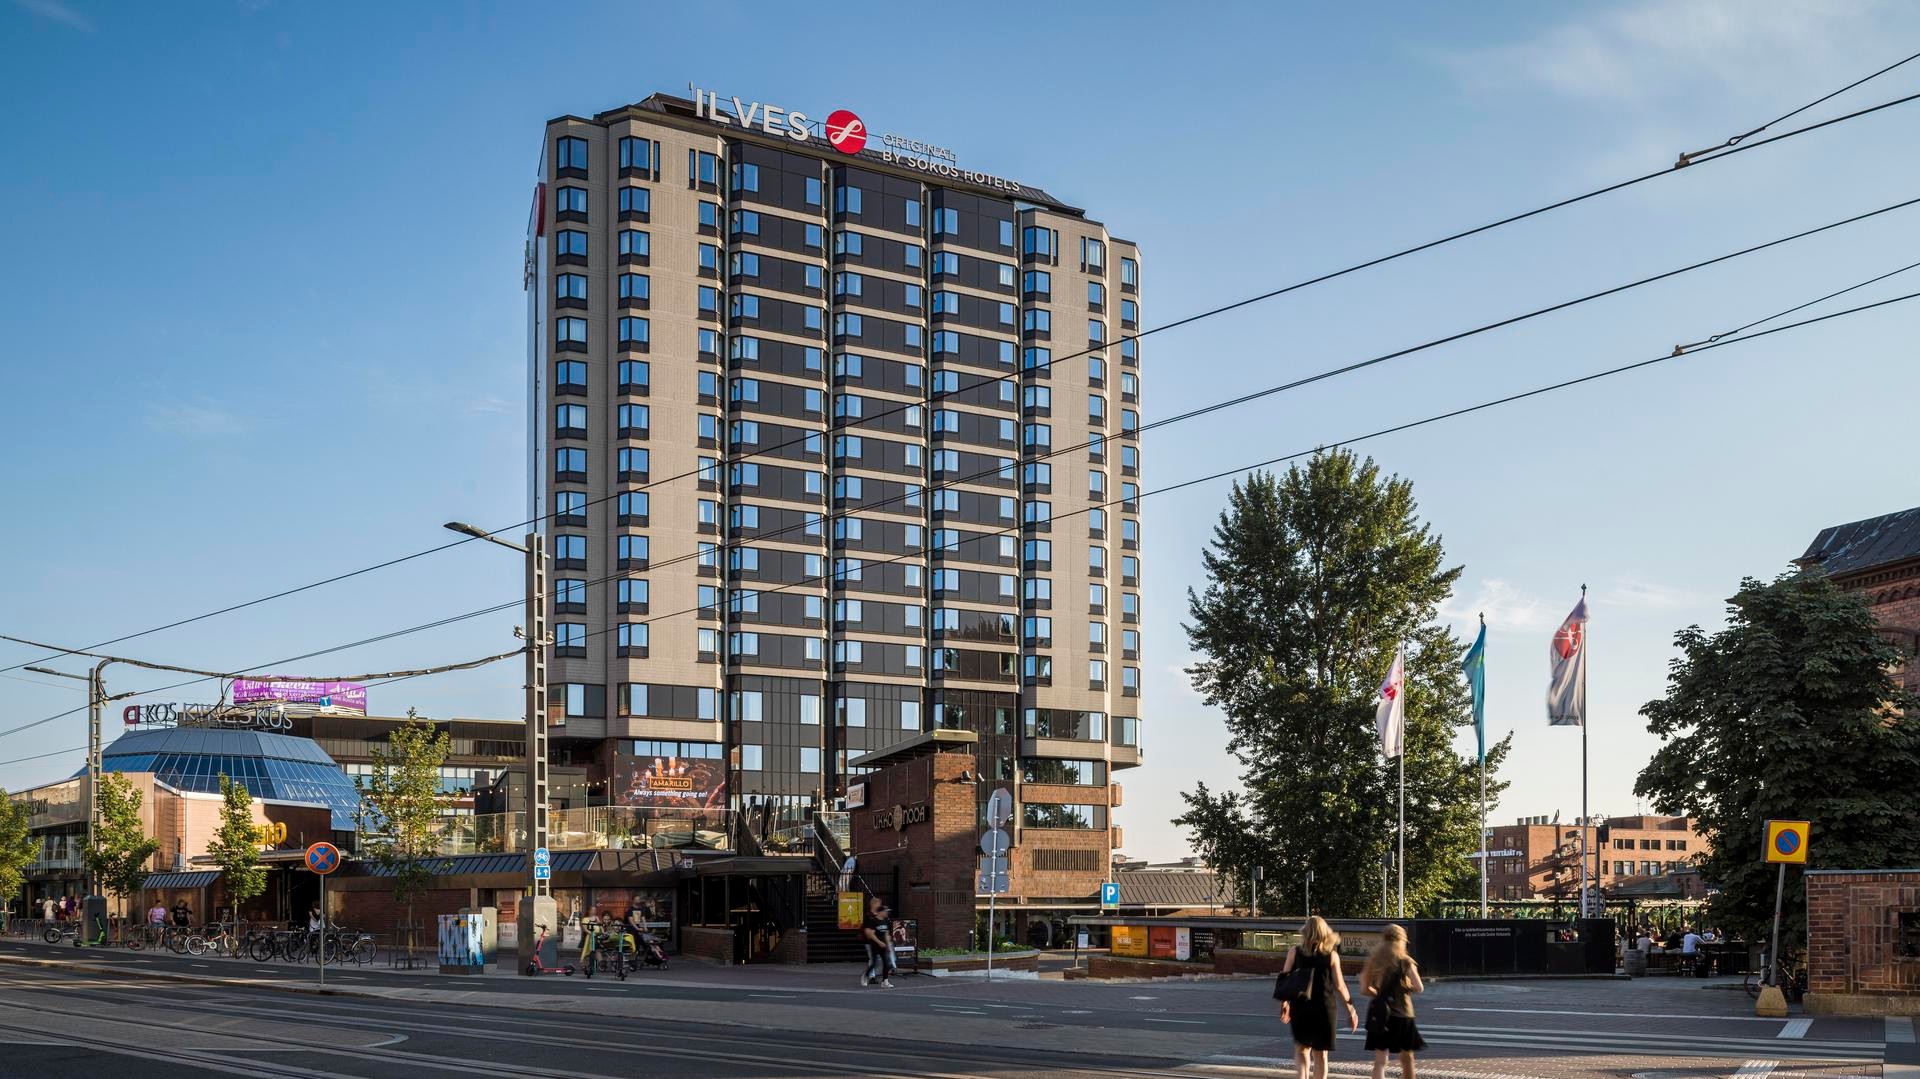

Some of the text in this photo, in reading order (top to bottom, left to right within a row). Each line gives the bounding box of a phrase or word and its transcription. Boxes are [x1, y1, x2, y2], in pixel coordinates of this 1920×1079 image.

[696, 88, 809, 141] ILVES
[882, 132, 957, 161] ORIGINAL
[882, 150, 1021, 192] BY SOKOS HOTELS
[652, 780, 690, 788] AMARILLO
[634, 789, 653, 797] Always
[653, 789, 682, 799] something
[682, 791, 698, 799] going
[1106, 886, 1116, 901] P
[1343, 936, 1363, 947] ILVES
